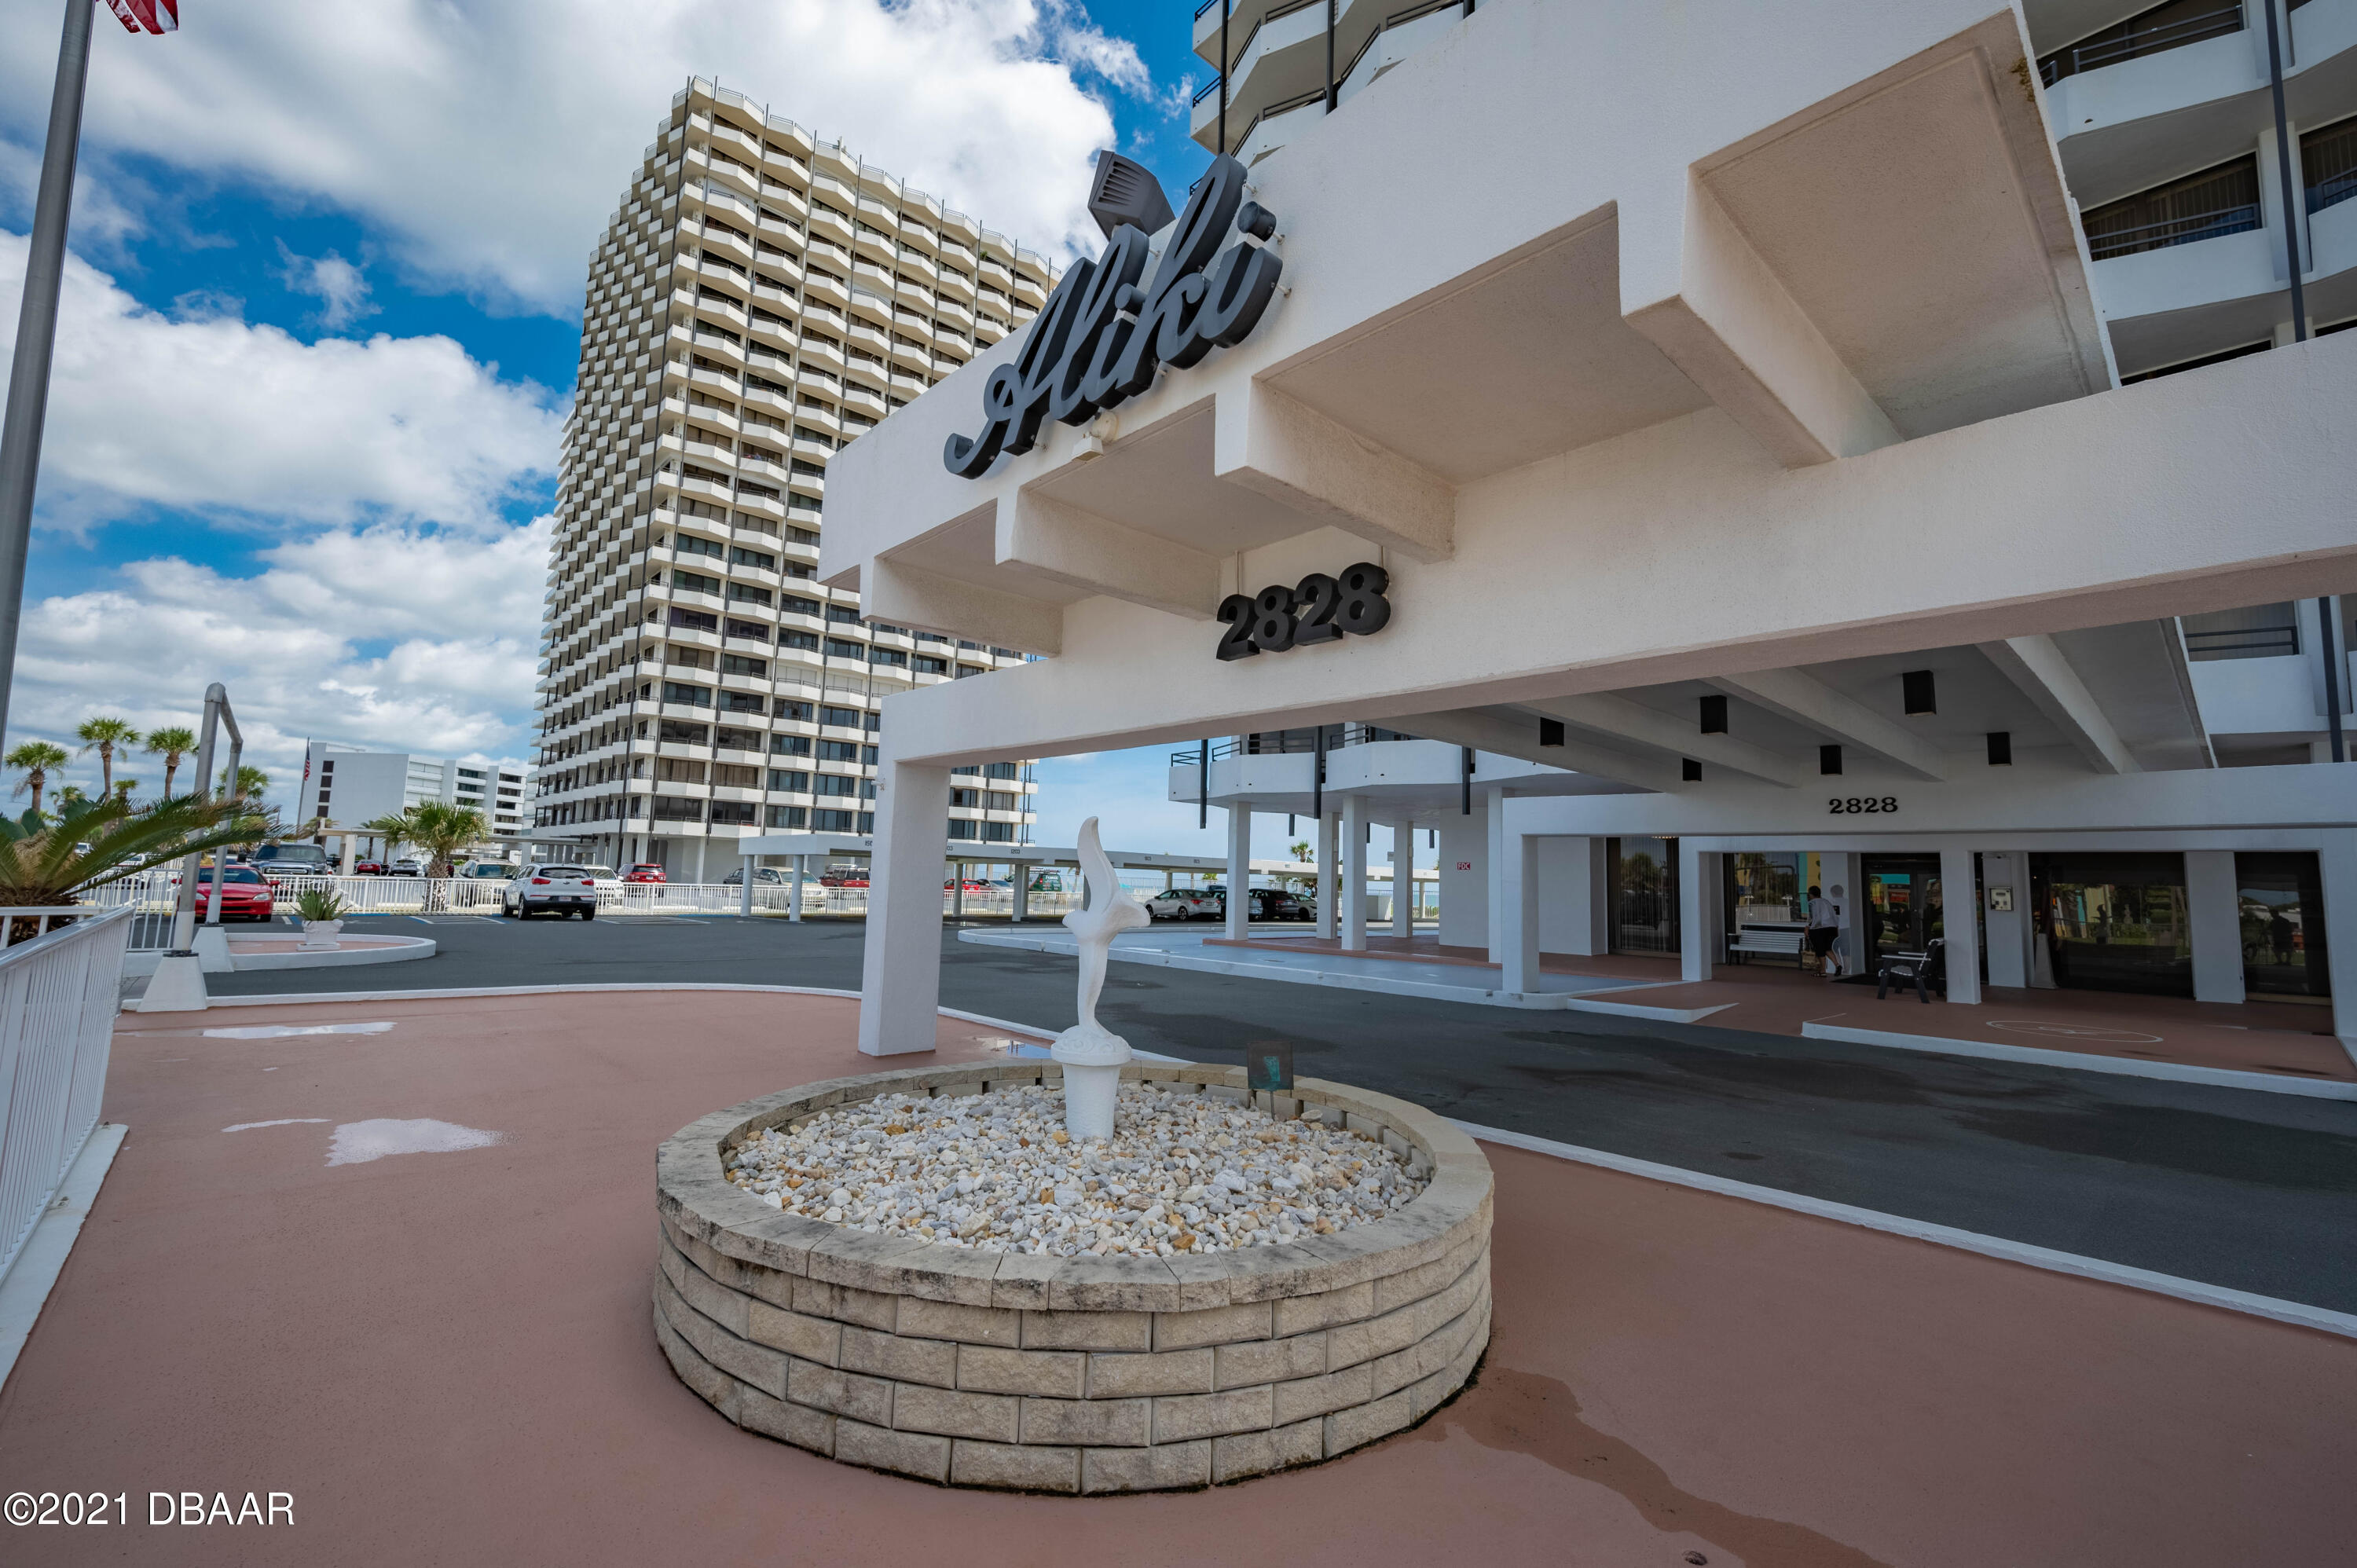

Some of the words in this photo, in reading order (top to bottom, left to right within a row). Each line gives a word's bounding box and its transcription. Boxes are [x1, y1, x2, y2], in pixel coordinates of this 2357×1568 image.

[944, 152, 1283, 479] Aliki
[1216, 562, 1391, 661] 2828
[1829, 797, 1898, 814] 2828
